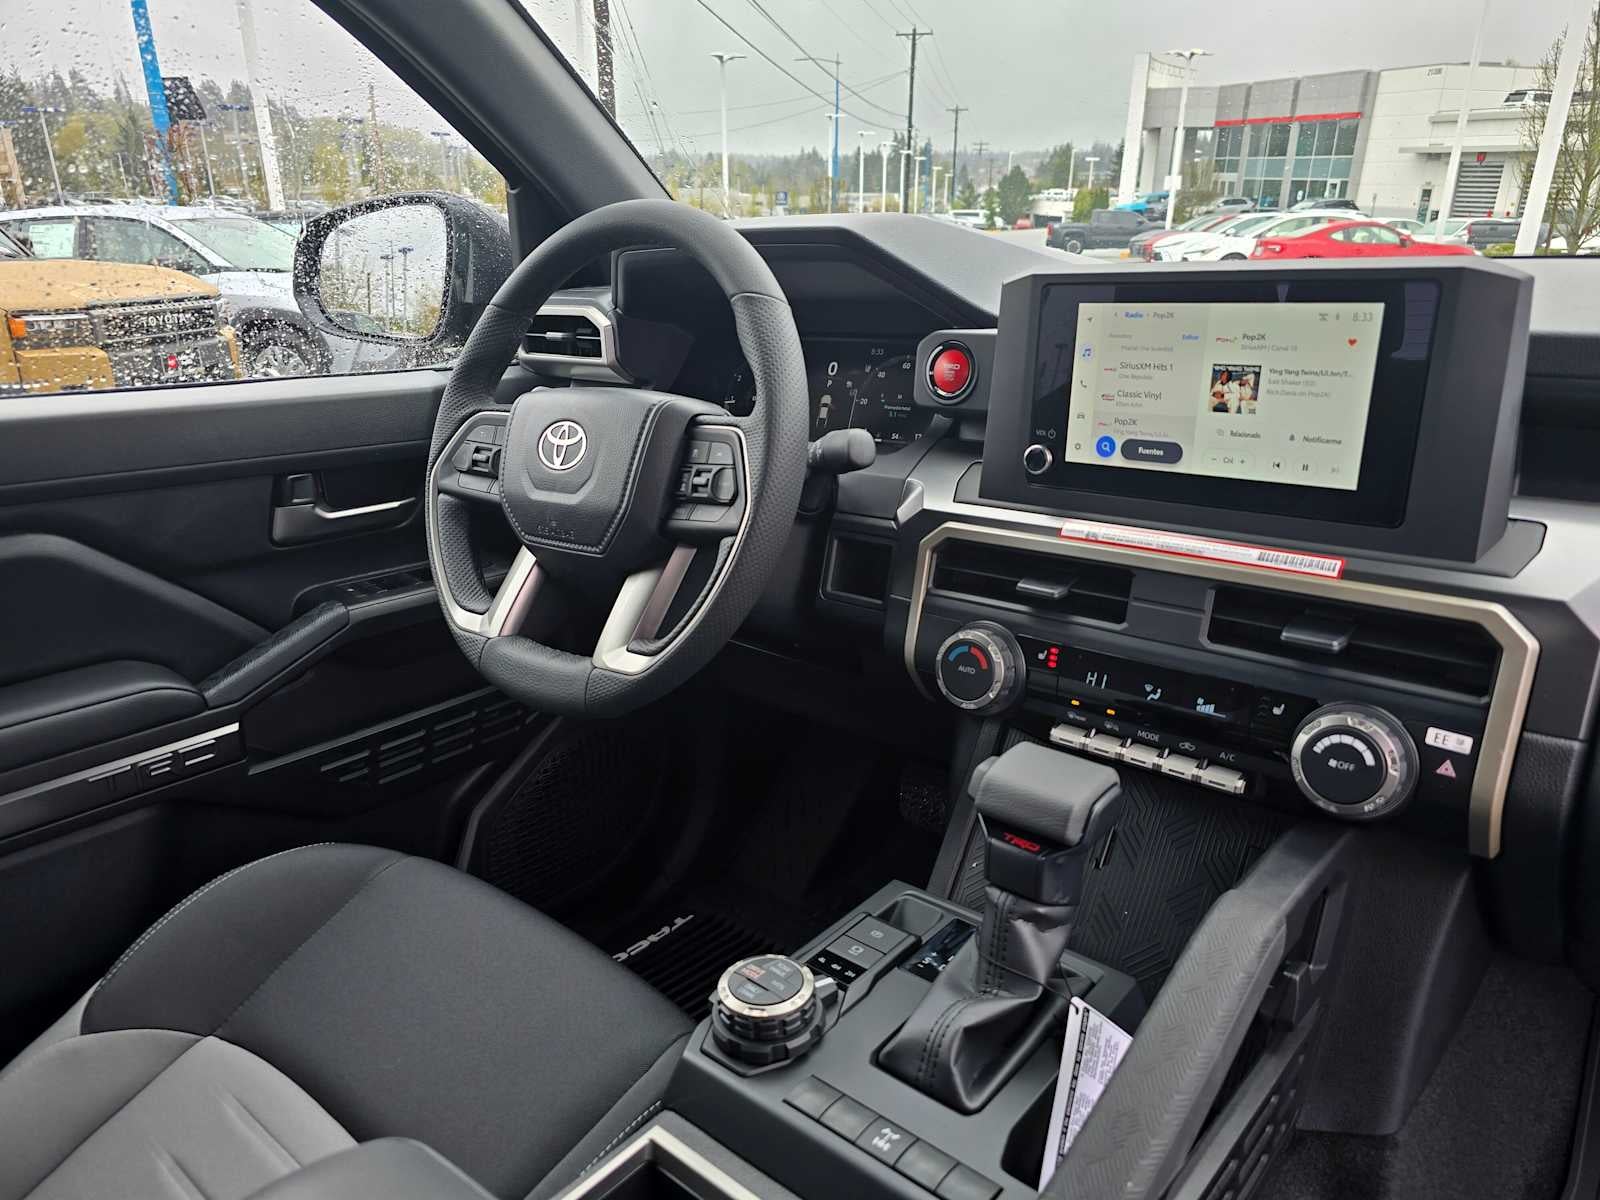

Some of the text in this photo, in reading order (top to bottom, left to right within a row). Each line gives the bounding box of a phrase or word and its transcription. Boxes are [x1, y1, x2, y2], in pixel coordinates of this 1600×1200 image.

[141, 313, 187, 328] TOYOTA
[1153, 311, 1175, 320] Pop2K
[1352, 311, 1374, 322] 8:33
[1242, 333, 1266, 342] Pop2K
[827, 361, 839, 376] 0
[1119, 361, 1151, 370] SiriusXM
[1152, 363, 1168, 371] Hits
[1117, 389, 1162, 400] Classic Vinyl
[1138, 446, 1164, 456] Fuentes
[958, 664, 976, 675] AUTO
[1085, 671, 1108, 689] HI
[1137, 730, 1160, 743] MODE
[1219, 751, 1236, 762] A/C
[1337, 760, 1355, 772] OFF
